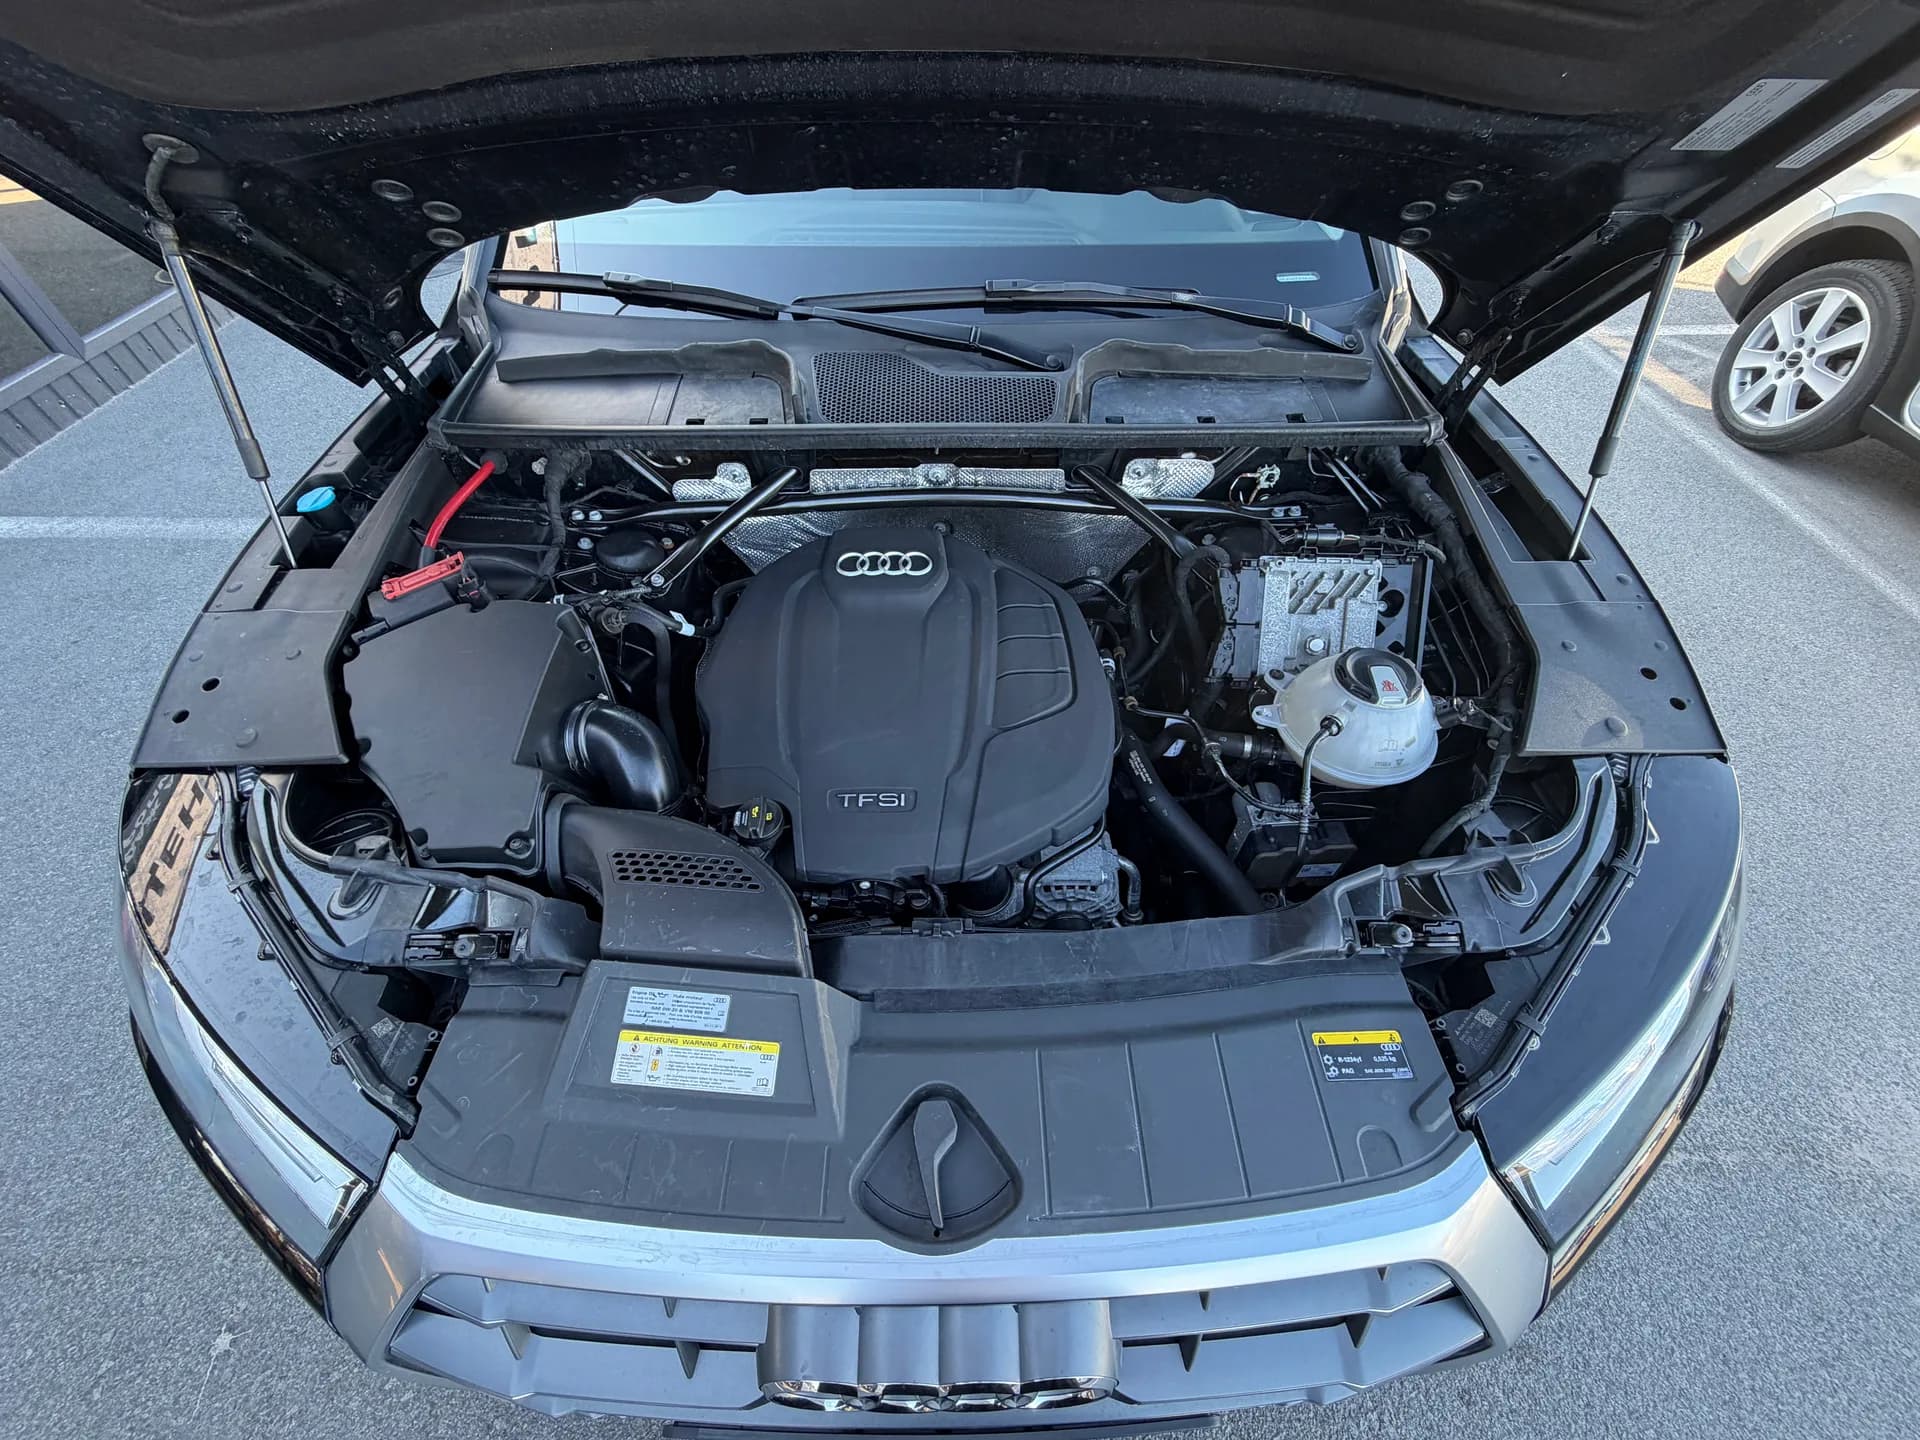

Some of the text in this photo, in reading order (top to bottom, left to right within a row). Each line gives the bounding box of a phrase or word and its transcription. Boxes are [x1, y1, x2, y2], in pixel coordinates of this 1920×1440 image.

[837, 793, 905, 807] TFSI
[643, 1036, 762, 1052] ACHTUNG WARNING ATTENTION
